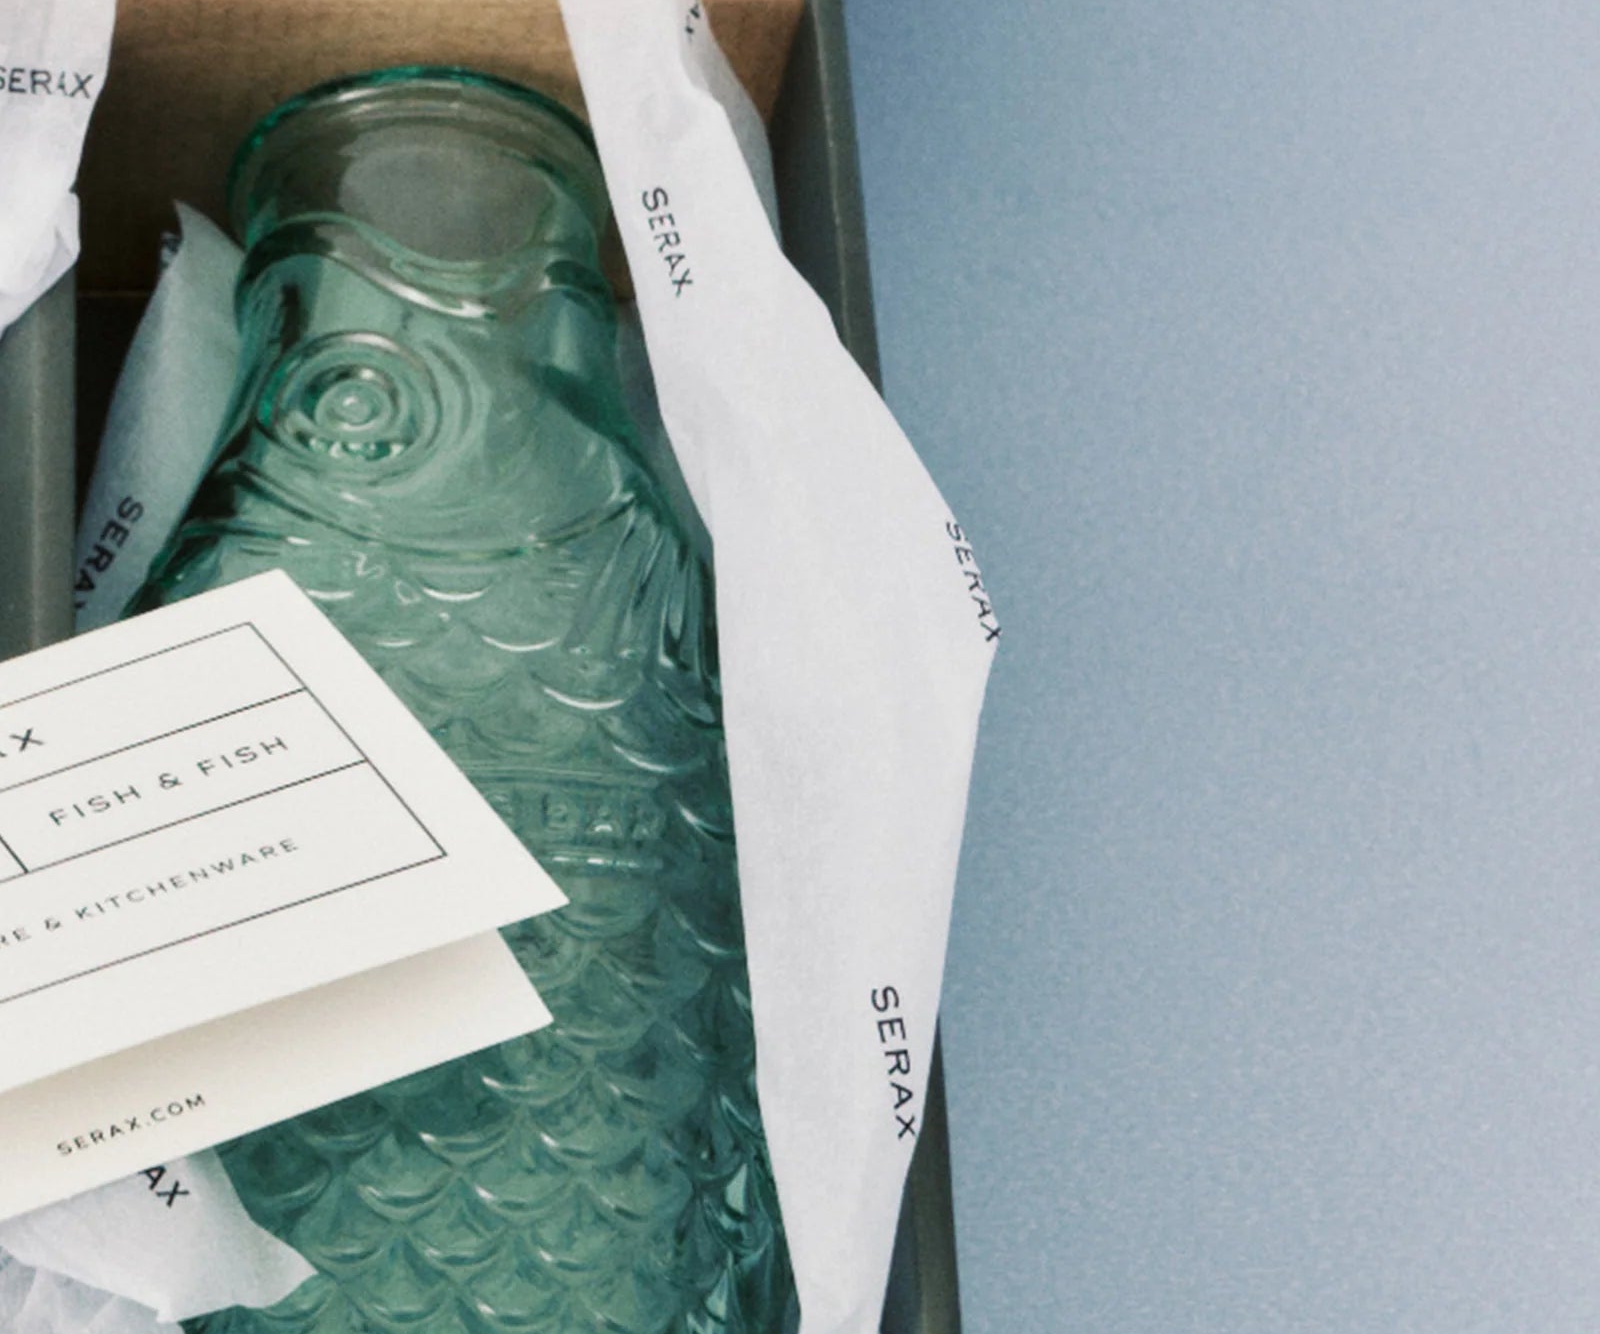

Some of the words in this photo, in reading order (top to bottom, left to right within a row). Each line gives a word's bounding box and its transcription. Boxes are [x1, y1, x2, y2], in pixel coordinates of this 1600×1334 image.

[641, 187, 693, 298] SERAX
[73, 496, 144, 610] SERA
[48, 785, 143, 827] FISH
[157, 771, 184, 791] &
[196, 735, 289, 778] FISH
[43, 915, 63, 933] &
[74, 836, 299, 923] KITCHENWARE
[871, 985, 916, 1141] SERAX
[55, 1092, 207, 1157] SERAX.COM
